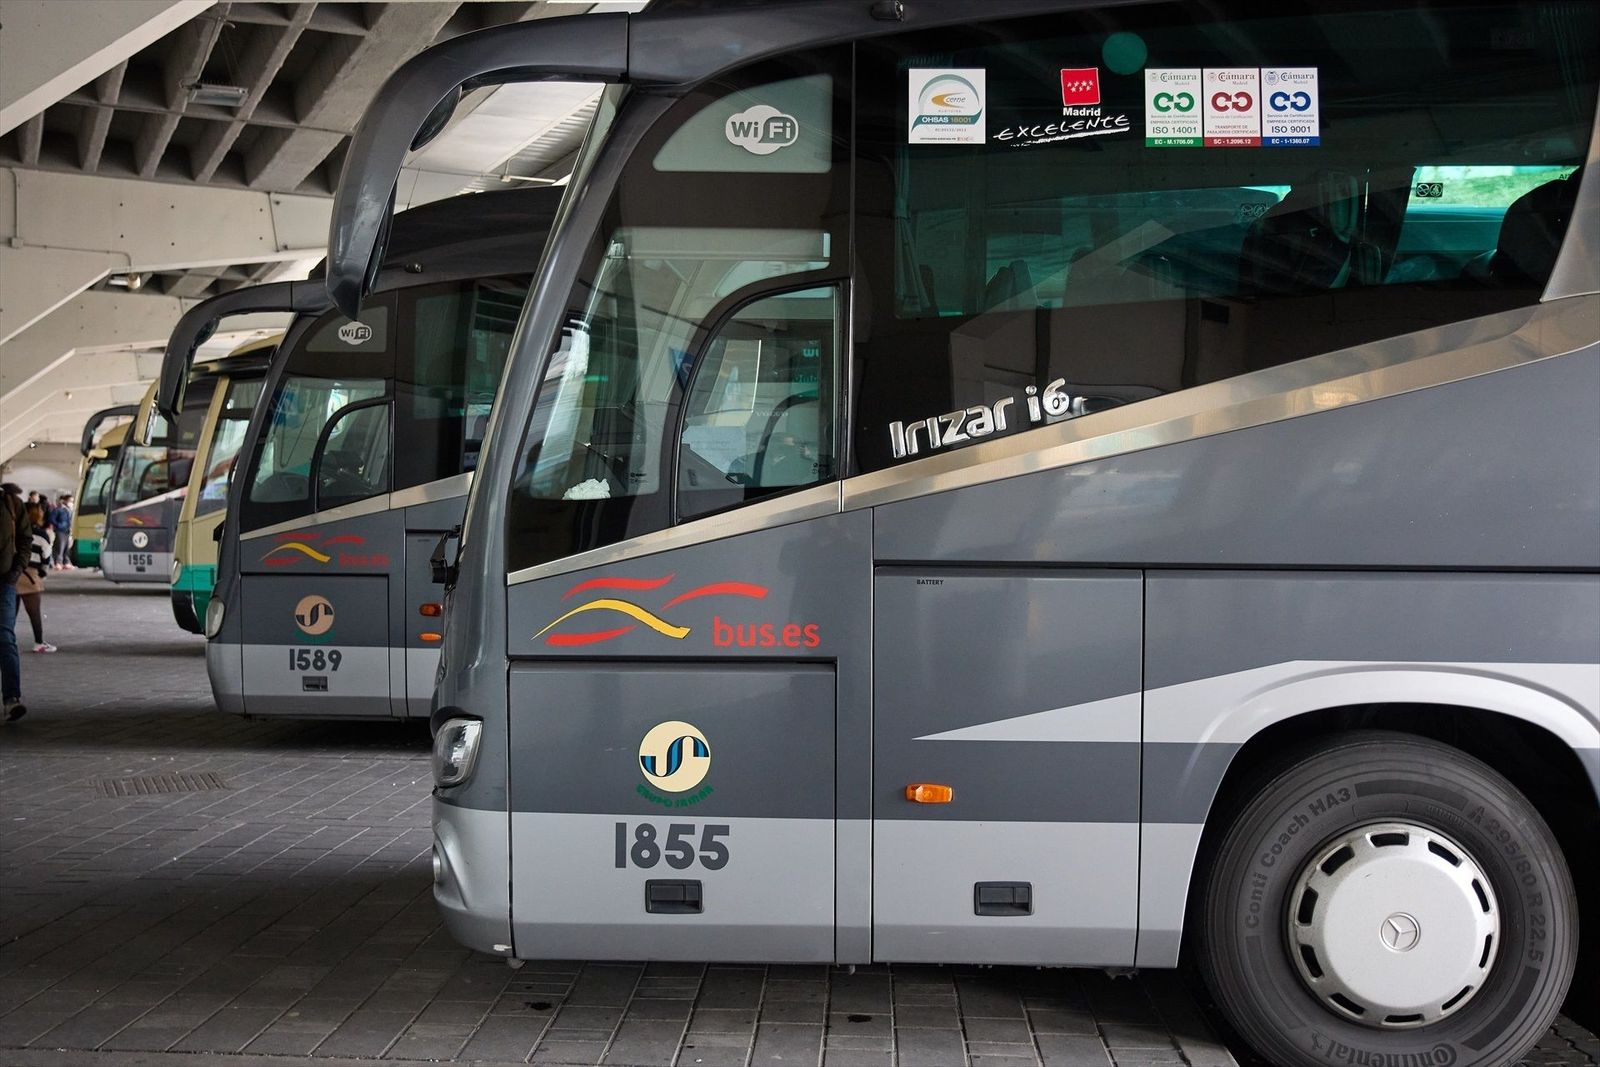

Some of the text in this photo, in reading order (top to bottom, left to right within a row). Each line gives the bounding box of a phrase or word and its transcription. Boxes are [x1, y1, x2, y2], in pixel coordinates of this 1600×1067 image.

[993, 114, 1130, 140] EXCELENTE
[1063, 107, 1101, 116] Madrid
[1153, 126, 1197, 134] ISO 14001
[889, 378, 1070, 459] Irizar i6
[713, 615, 820, 648] bus.es
[289, 648, 342, 671] 1589
[615, 822, 730, 871] 1855
[1245, 787, 1351, 928] Conti Coach HA3
[1485, 818, 1538, 886] 295/80
[1529, 914, 1546, 963] 22.5
